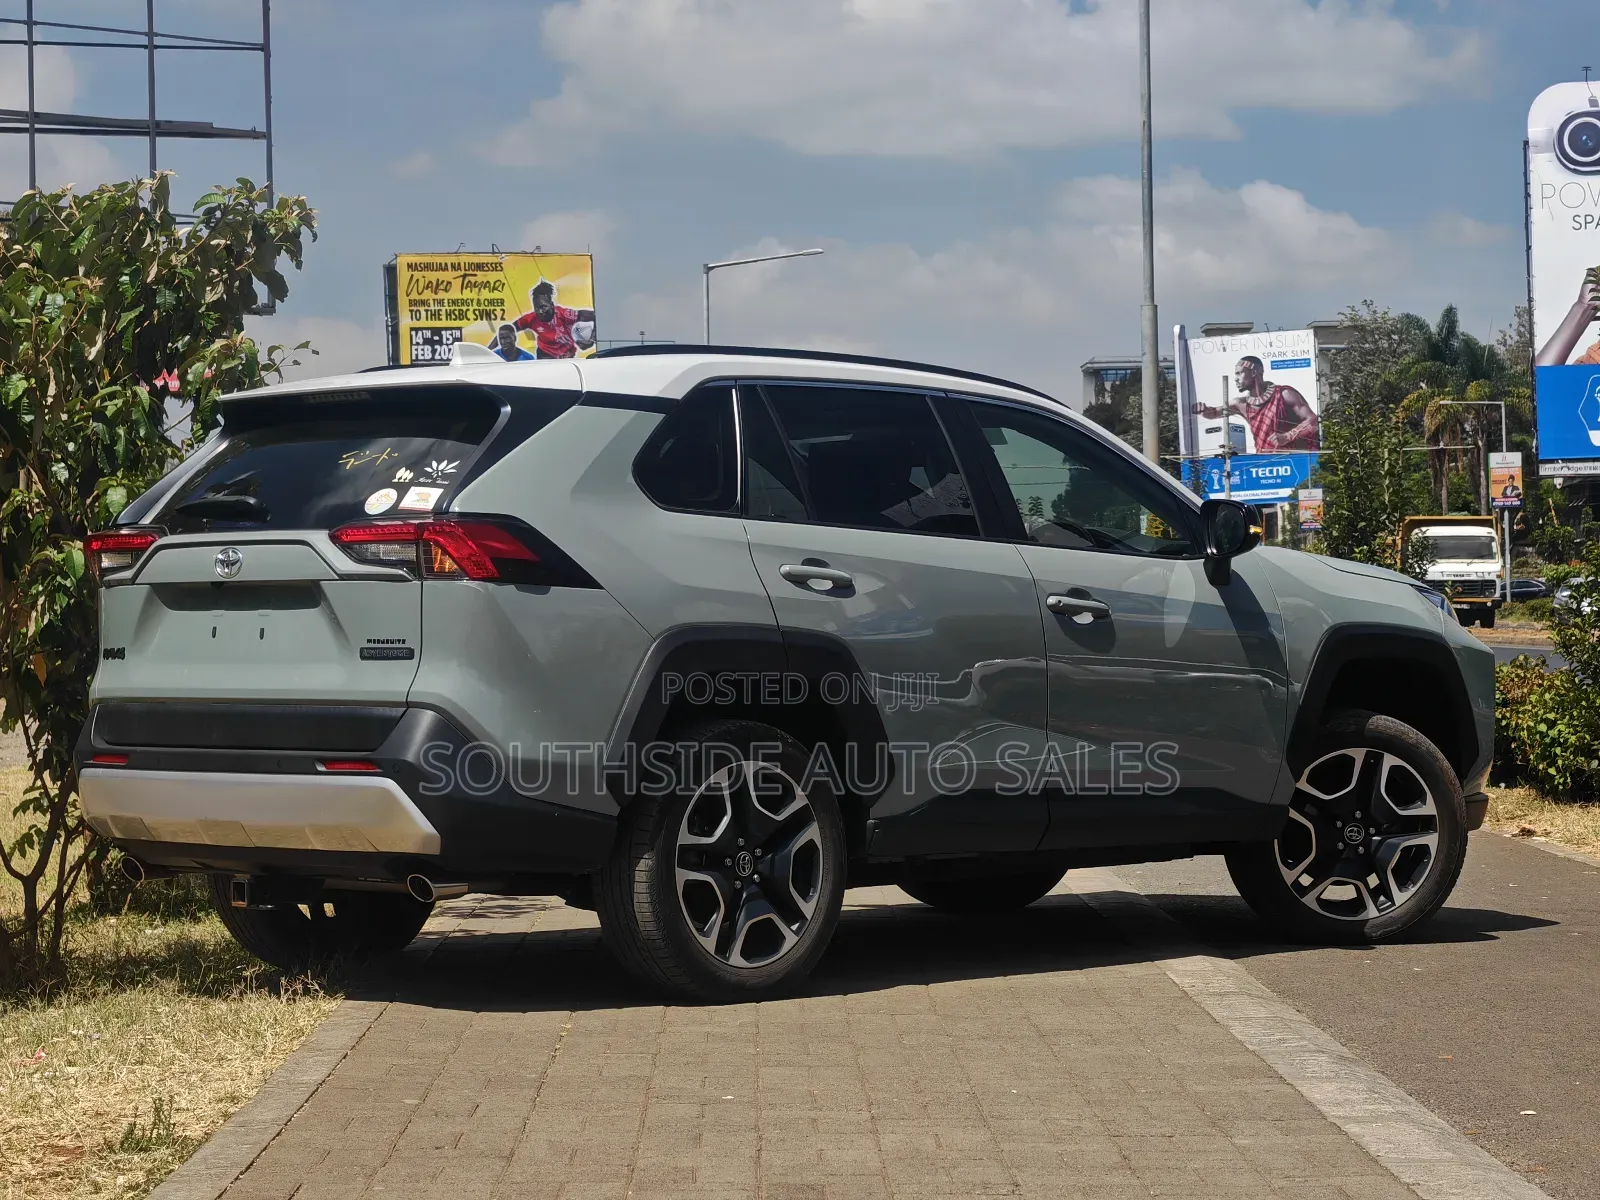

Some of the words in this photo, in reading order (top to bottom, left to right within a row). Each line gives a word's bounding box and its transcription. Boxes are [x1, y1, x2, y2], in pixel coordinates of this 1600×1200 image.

[407, 262, 449, 272] MASHUJAA
[451, 262, 462, 272] NA
[464, 262, 504, 272] LIONESSES
[409, 299, 431, 308] BRING
[432, 298, 446, 307] THE
[448, 298, 475, 307] ENERGY
[476, 298, 482, 307] &
[483, 298, 505, 307] CHEER
[409, 309, 421, 321] TO
[424, 309, 443, 321] THE
[445, 309, 470, 321] HSBC
[473, 309, 498, 321] SVNS
[500, 308, 506, 321] 2
[411, 329, 431, 344] 14TH
[441, 329, 460, 344] 15TH
[1193, 337, 1248, 354] POWER
[1253, 336, 1268, 349] IN
[1275, 333, 1310, 349] SLIM
[412, 345, 432, 360] FEB
[434, 345, 454, 360] 202
[1262, 351, 1288, 359] SPARK
[1291, 349, 1309, 357] SLIM
[1250, 466, 1291, 478] TECNO
